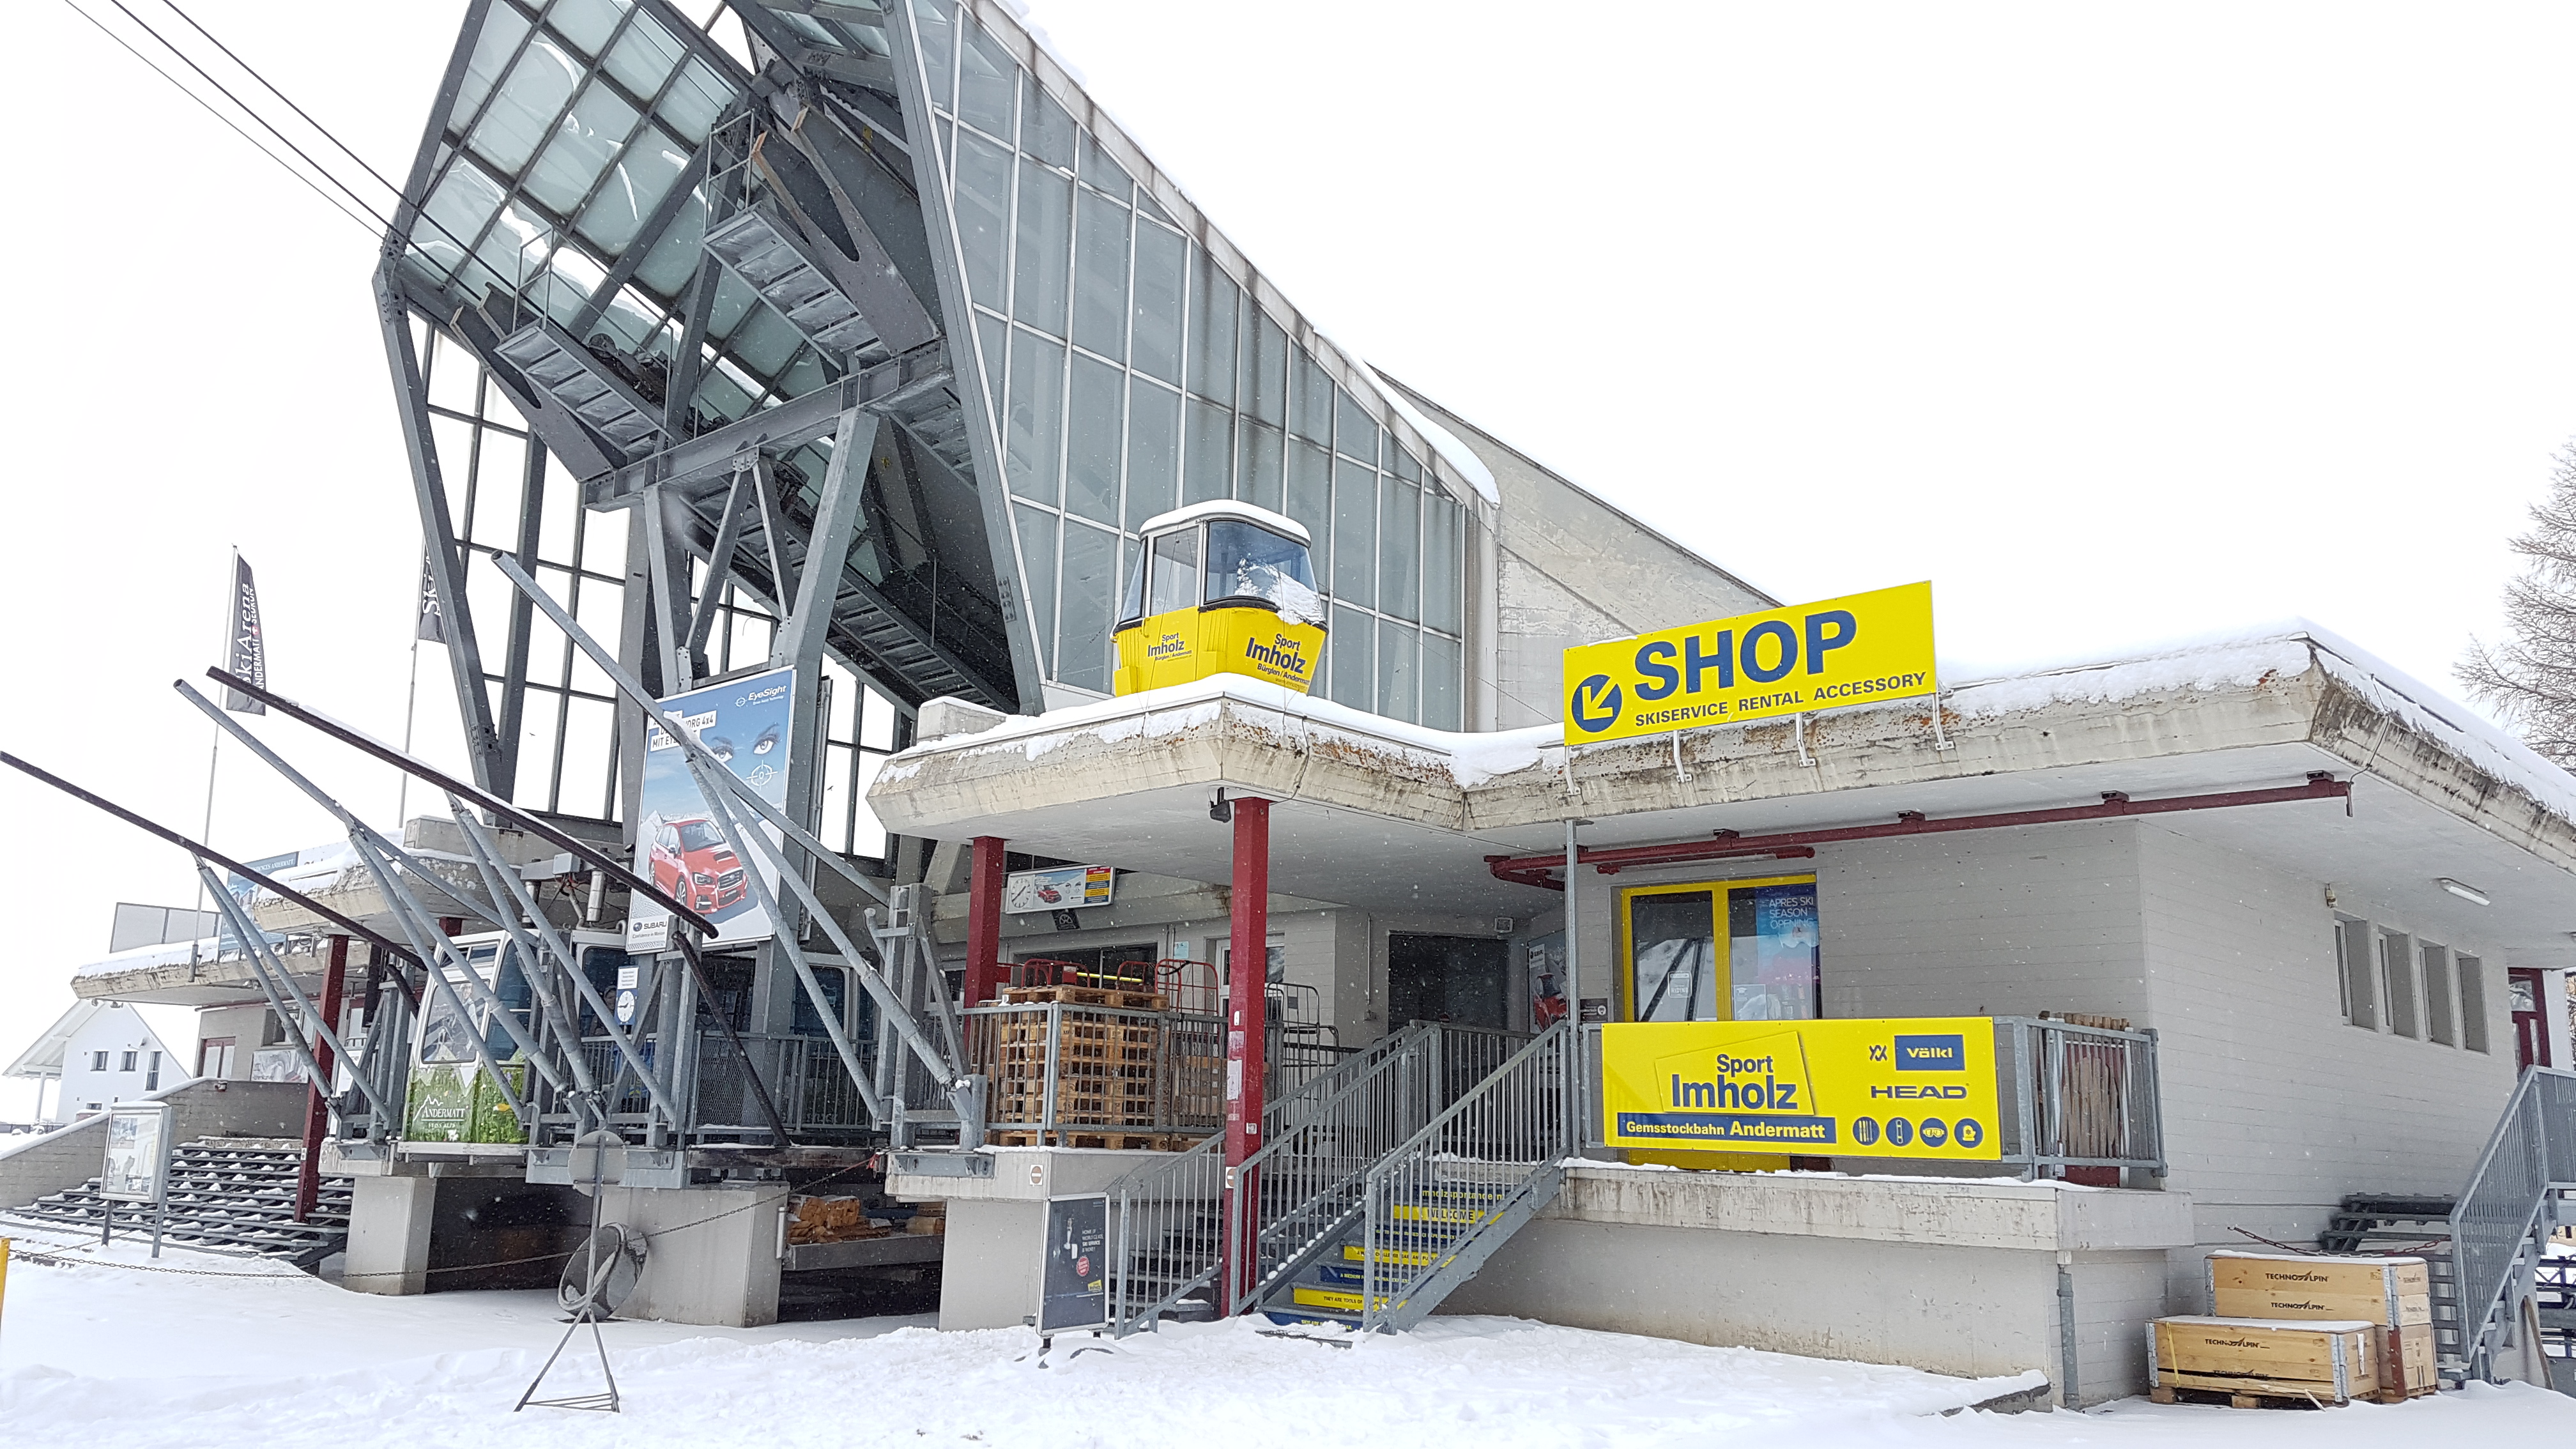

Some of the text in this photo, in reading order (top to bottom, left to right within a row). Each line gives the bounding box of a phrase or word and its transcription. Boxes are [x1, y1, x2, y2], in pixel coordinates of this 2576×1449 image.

[1162, 632, 1179, 643] Sport
[1275, 633, 1301, 651] Sport
[1147, 640, 1185, 657] Imholz
[1245, 637, 1306, 674] Imholz
[1634, 610, 1857, 700] SHOP
[1257, 663, 1280, 677] Bürglen
[748, 686, 787, 701] EyeSight
[1635, 671, 1927, 727] SKISERVICE RENTAL ACCESSORY
[702, 714, 714, 725] 4x4
[652, 737, 664, 748] MIT
[1768, 896, 1814, 907] APRES SKI
[1769, 907, 1808, 918] SEASON
[643, 921, 667, 930] SUBARU
[1770, 918, 1814, 929] OPENING
[1906, 1047, 1953, 1058] Völkl
[1717, 1054, 1774, 1078] Sport
[1671, 1073, 1798, 1110] Imholz
[1871, 1085, 1967, 1099] HEAD
[422, 1106, 465, 1118] ANDERMATT
[1626, 1121, 1826, 1138] Gemsstockbahn Andermatt
[2265, 1270, 2329, 1282] TECHNOALPIN
